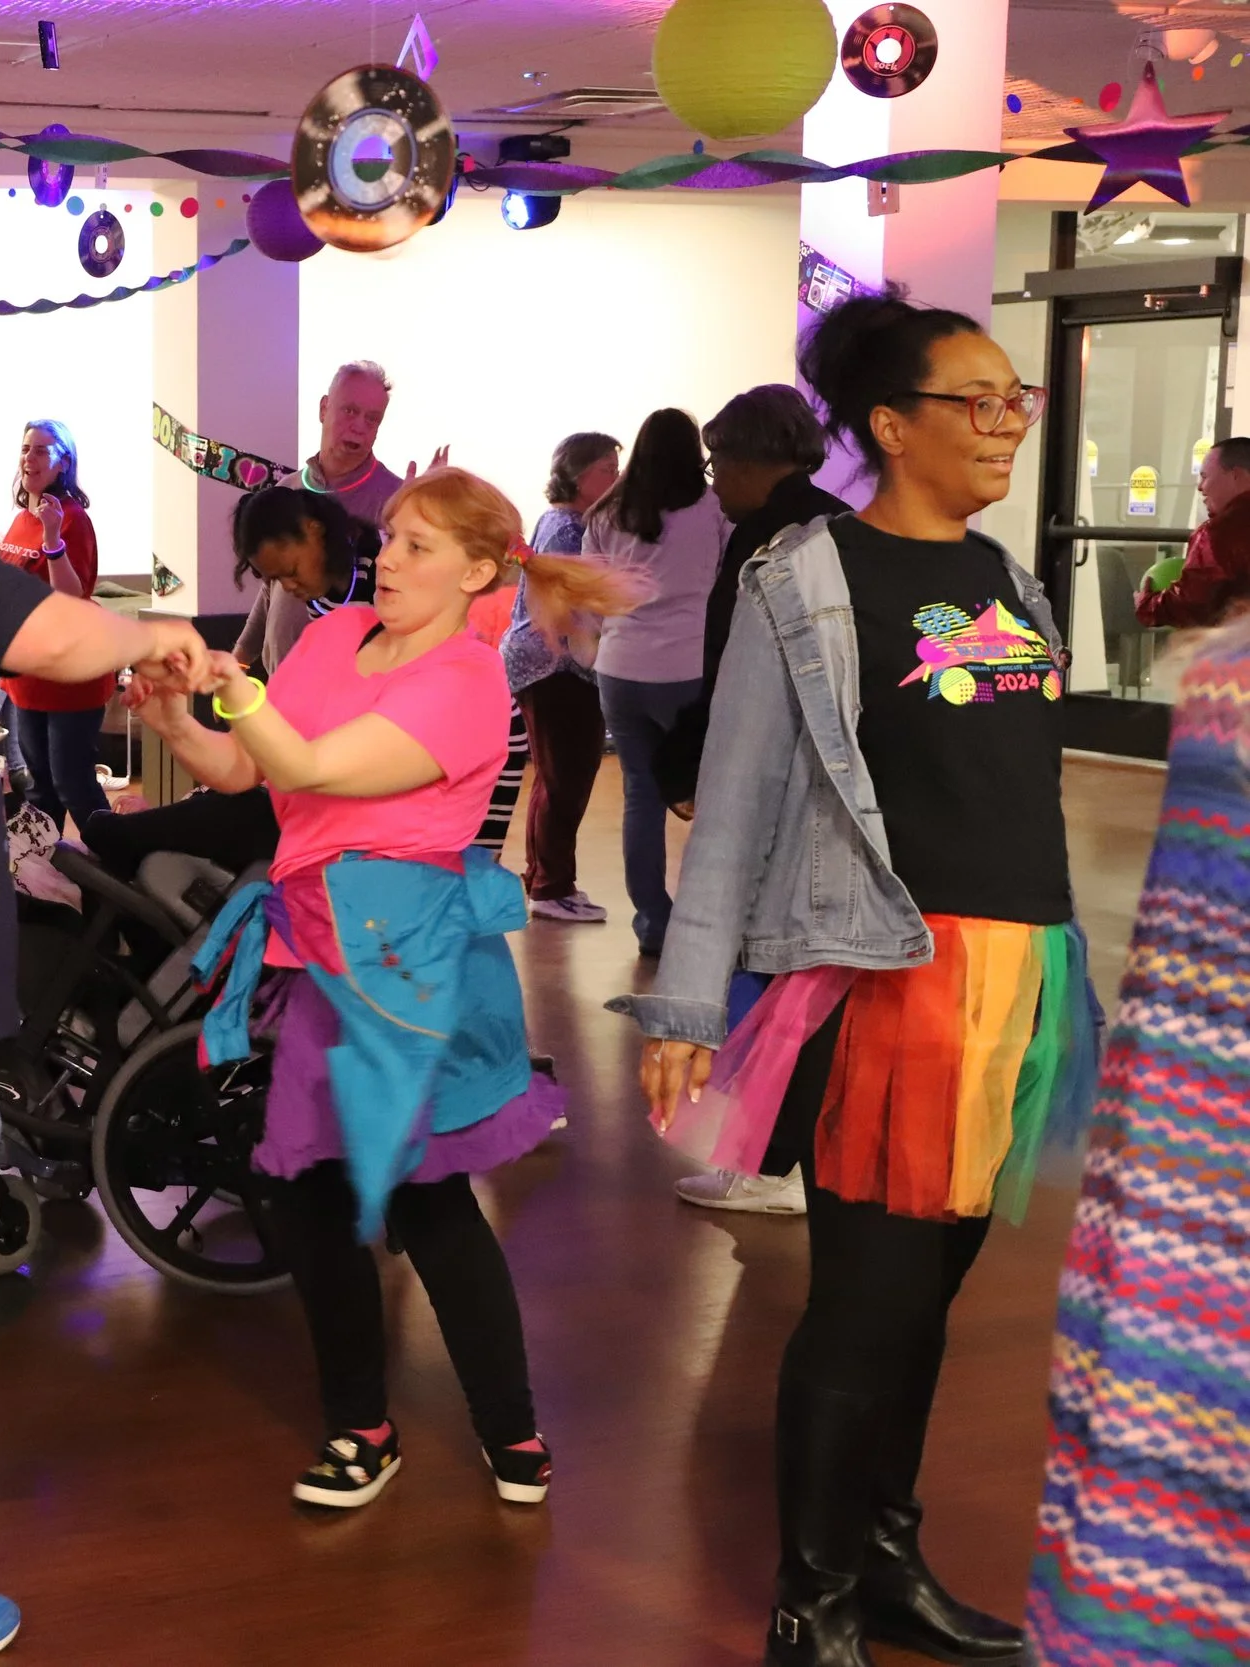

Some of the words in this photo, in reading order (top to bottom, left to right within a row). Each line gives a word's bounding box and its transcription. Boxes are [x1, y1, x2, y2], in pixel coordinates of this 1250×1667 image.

[873, 61, 898, 71] rock
[1131, 479, 1156, 489] CAUTION
[0, 543, 22, 554] ORN
[22, 548, 40, 558] TO
[1006, 643, 1046, 657] WALK
[994, 672, 1040, 691] 2024
